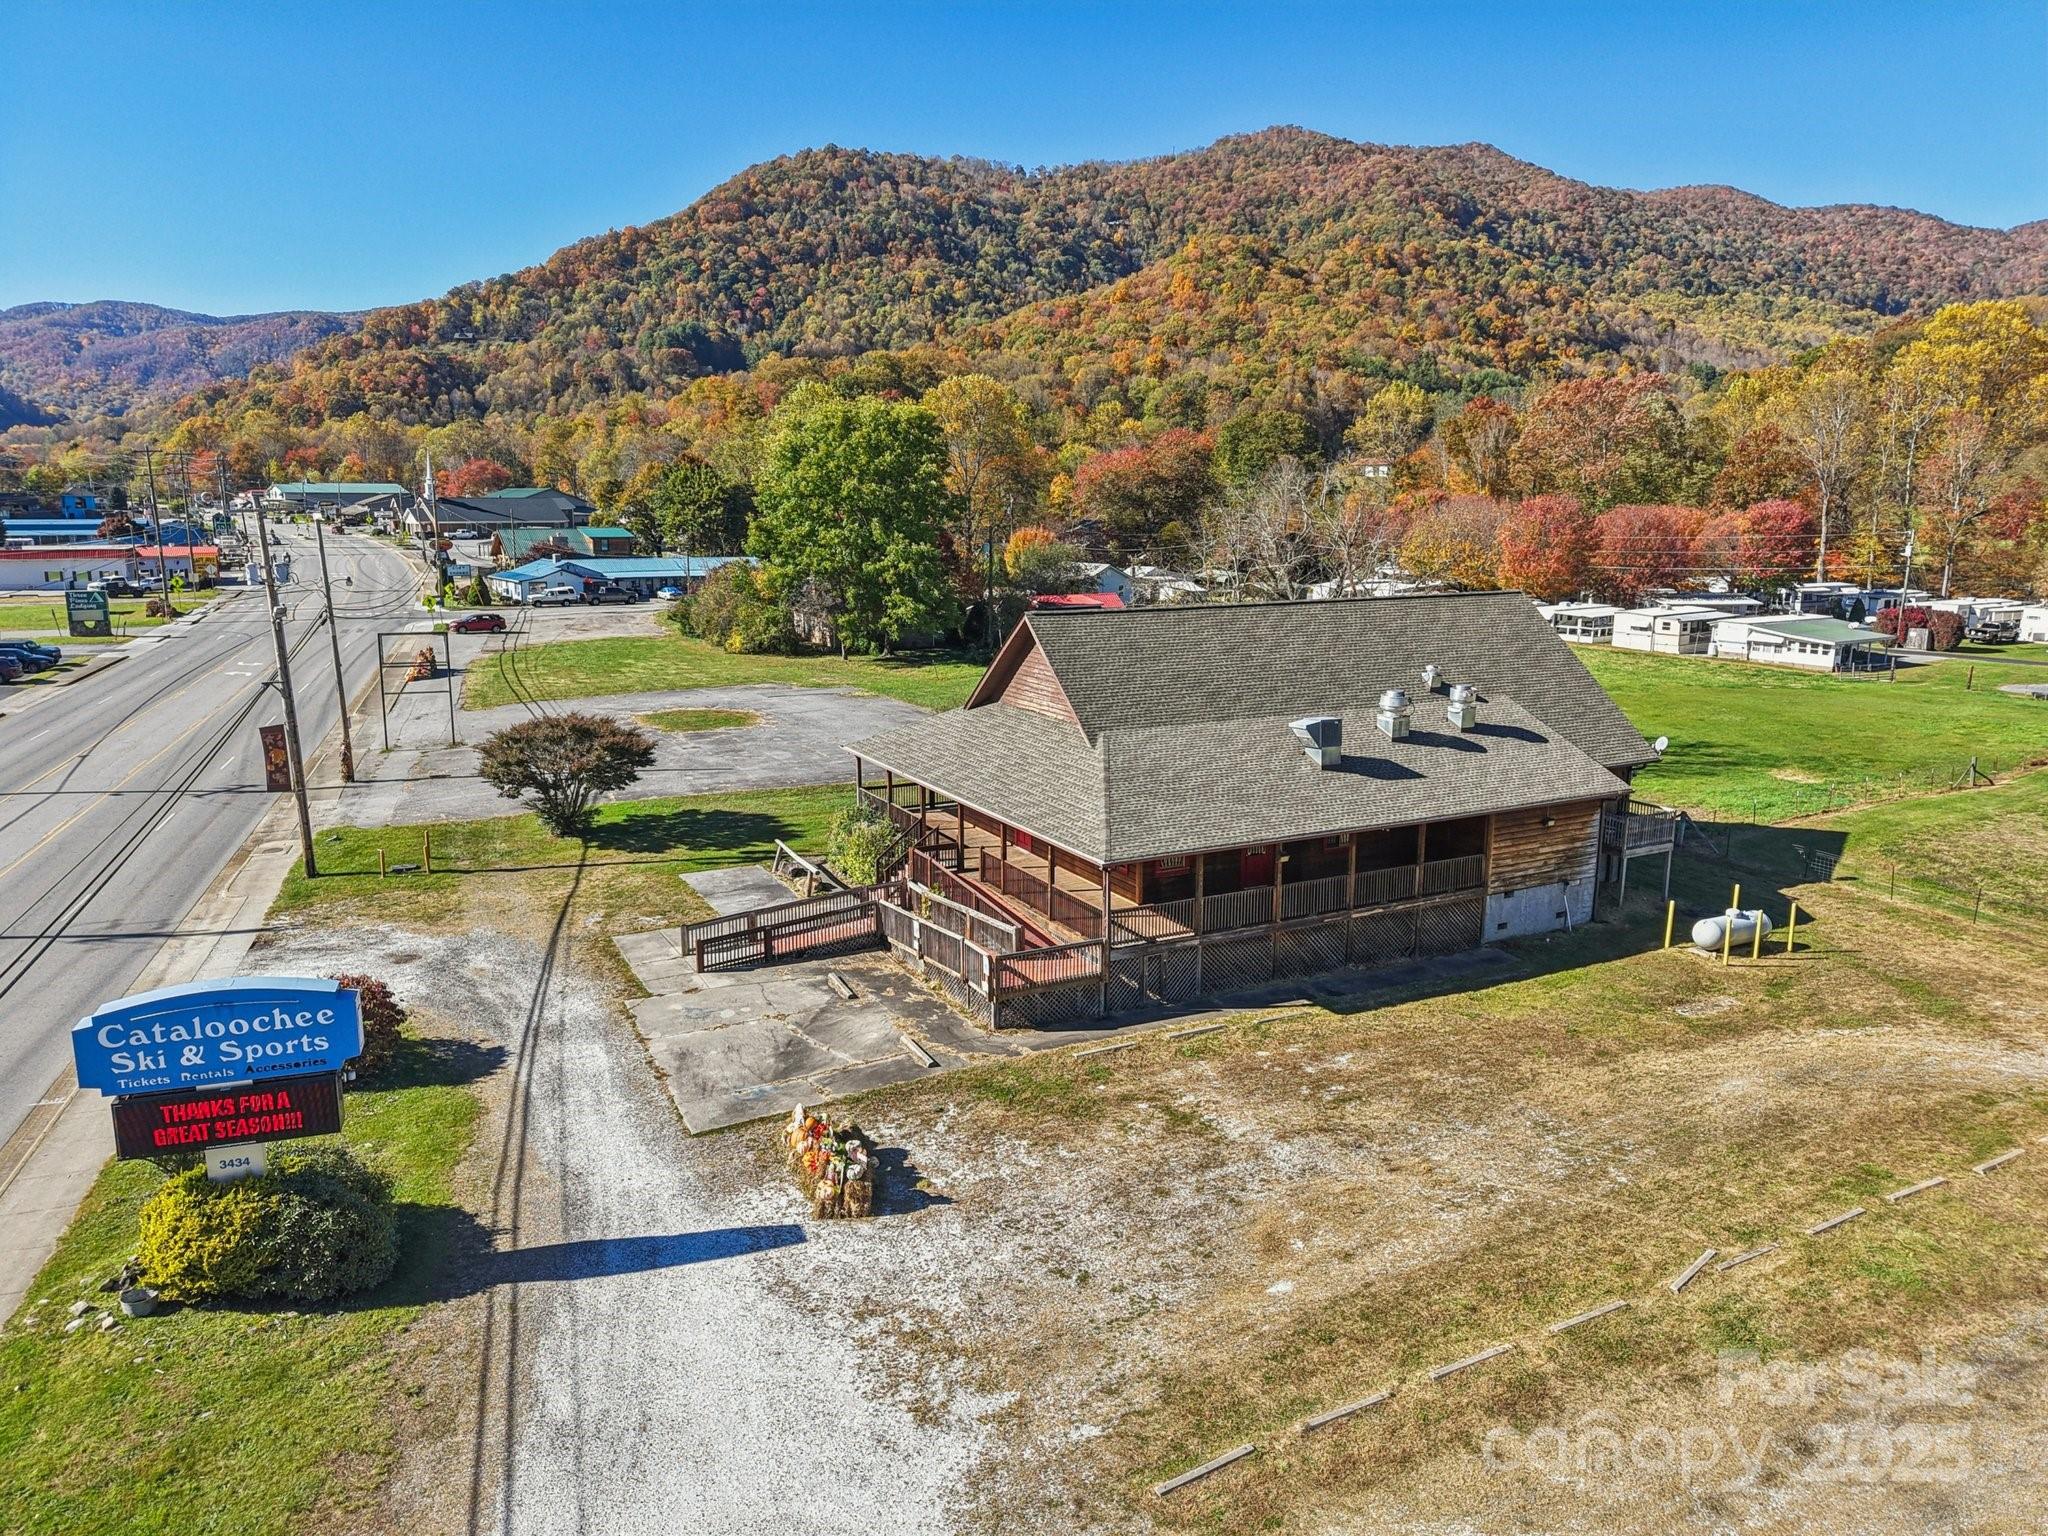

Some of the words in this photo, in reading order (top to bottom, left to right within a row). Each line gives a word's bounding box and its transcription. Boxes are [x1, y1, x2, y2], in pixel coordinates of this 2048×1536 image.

[98, 1007, 335, 1048] Cataloochee
[110, 1050, 167, 1074] Ski
[180, 1045, 206, 1067] &
[219, 1034, 329, 1063] Sports
[118, 1075, 170, 1089] Tickets
[181, 1068, 234, 1082] Rentals
[244, 1058, 327, 1074] Accessories
[160, 1097, 235, 1123] THANKS
[240, 1093, 274, 1113] FOR
[277, 1091, 291, 1109] A
[153, 1122, 211, 1147] GREAT
[215, 1112, 304, 1139] SEASON!!!
[219, 1157, 250, 1169] 3434
